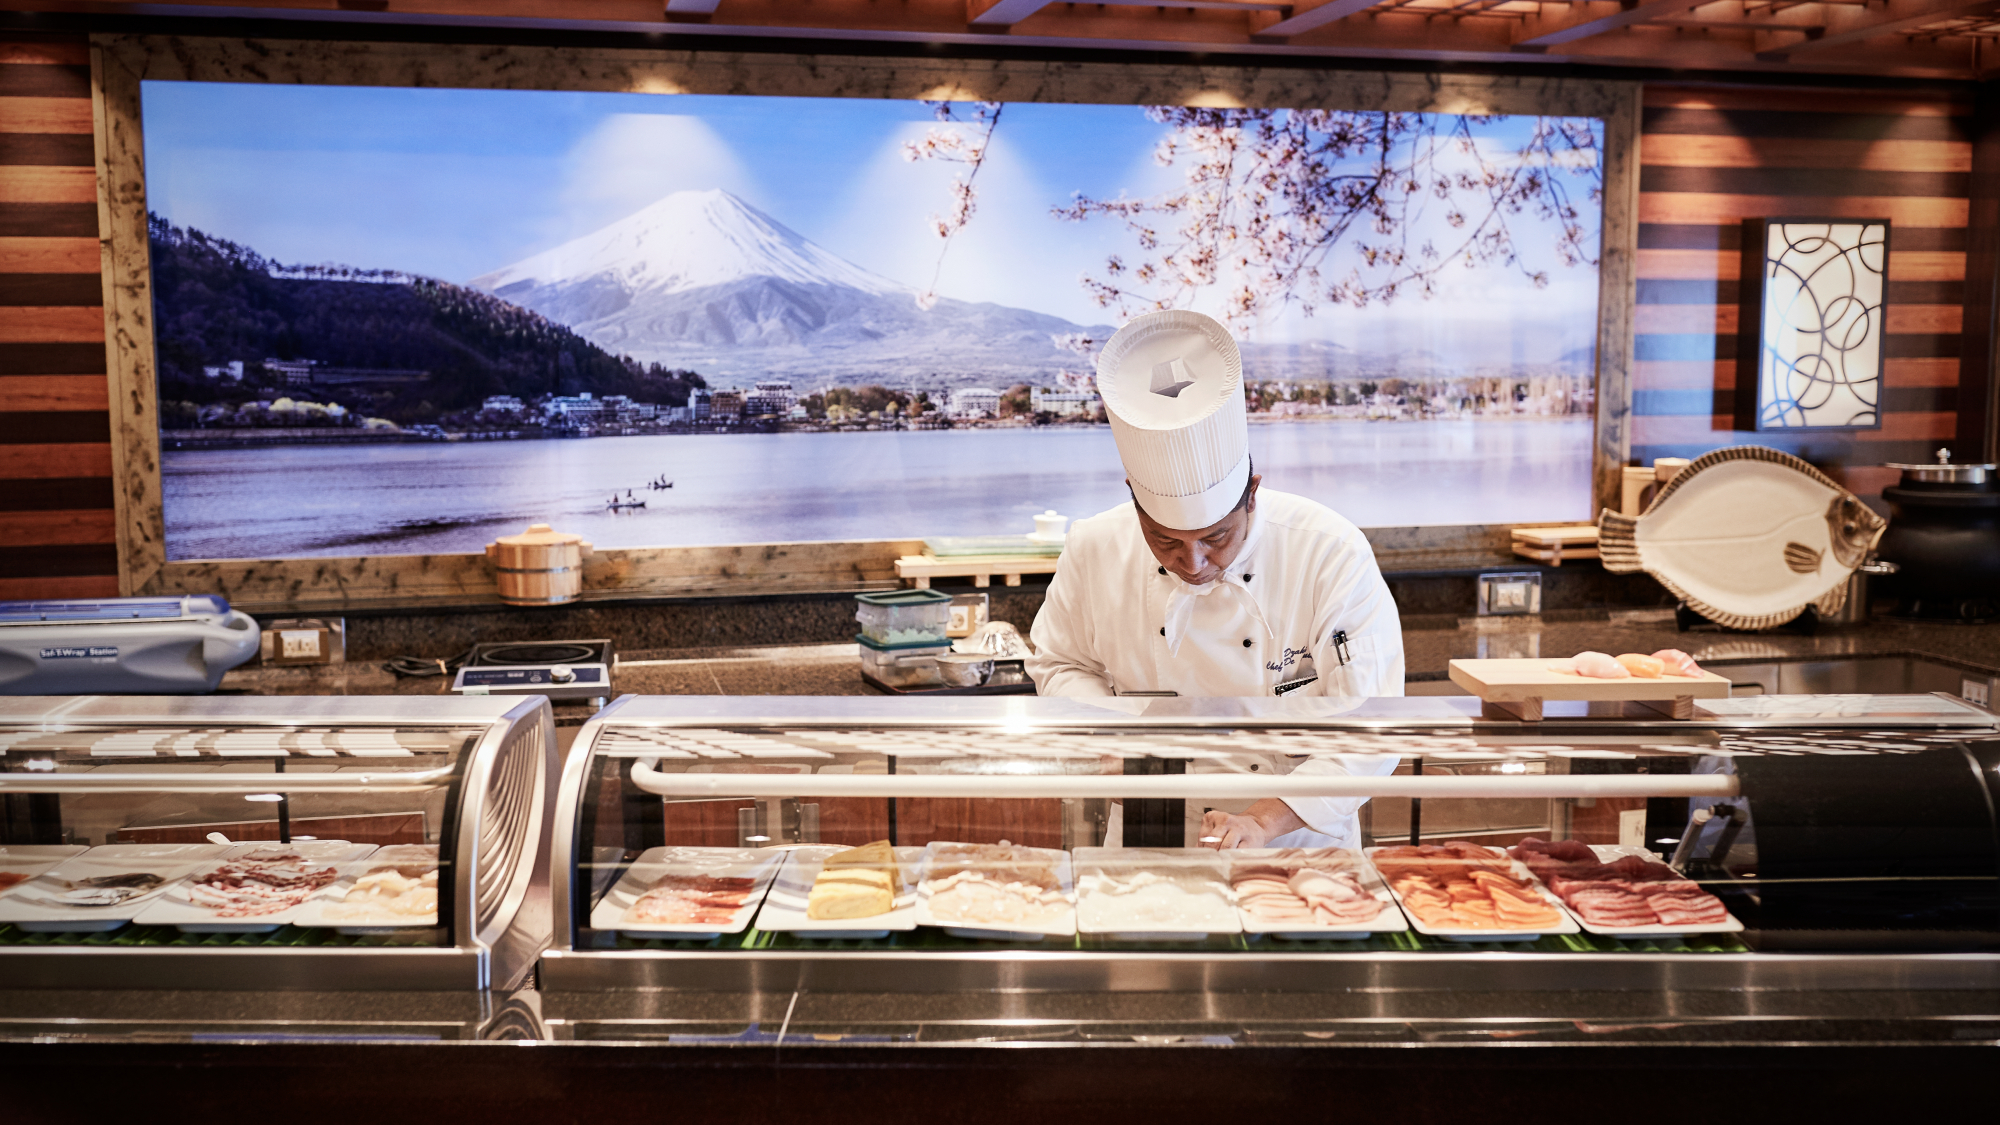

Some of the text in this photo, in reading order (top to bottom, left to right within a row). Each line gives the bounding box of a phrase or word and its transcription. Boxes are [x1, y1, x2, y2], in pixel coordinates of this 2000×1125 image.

[90, 647, 118, 655] Station
[1266, 661, 1283, 672] Chef
[1284, 657, 1295, 666] De
